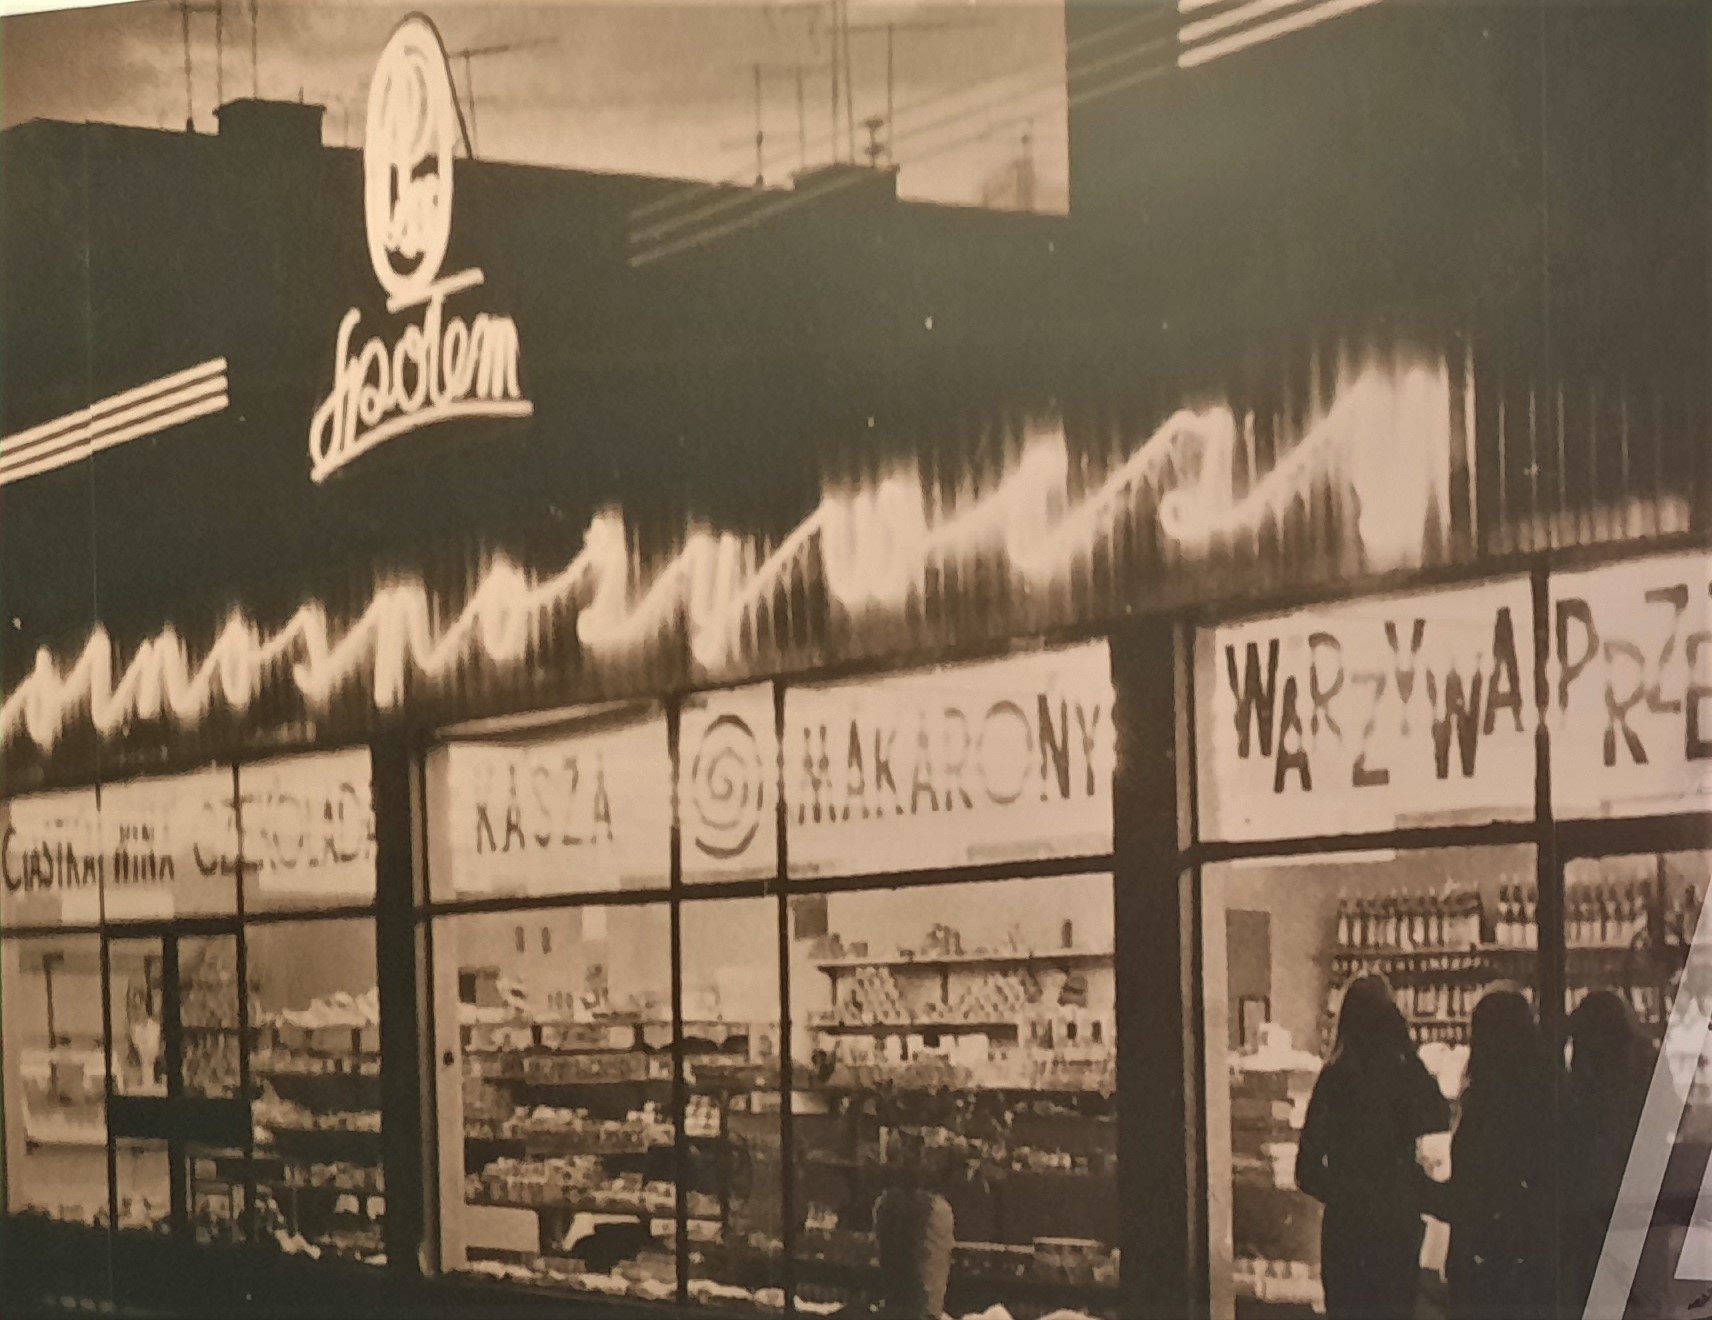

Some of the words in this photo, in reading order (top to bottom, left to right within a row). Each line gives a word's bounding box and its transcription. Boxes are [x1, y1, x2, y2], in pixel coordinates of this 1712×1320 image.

[475, 757, 614, 855] KASZA
[797, 692, 1101, 825] MAKARONY
[1224, 606, 1526, 795] WARZYWA
[1555, 581, 1712, 768] PRZE
